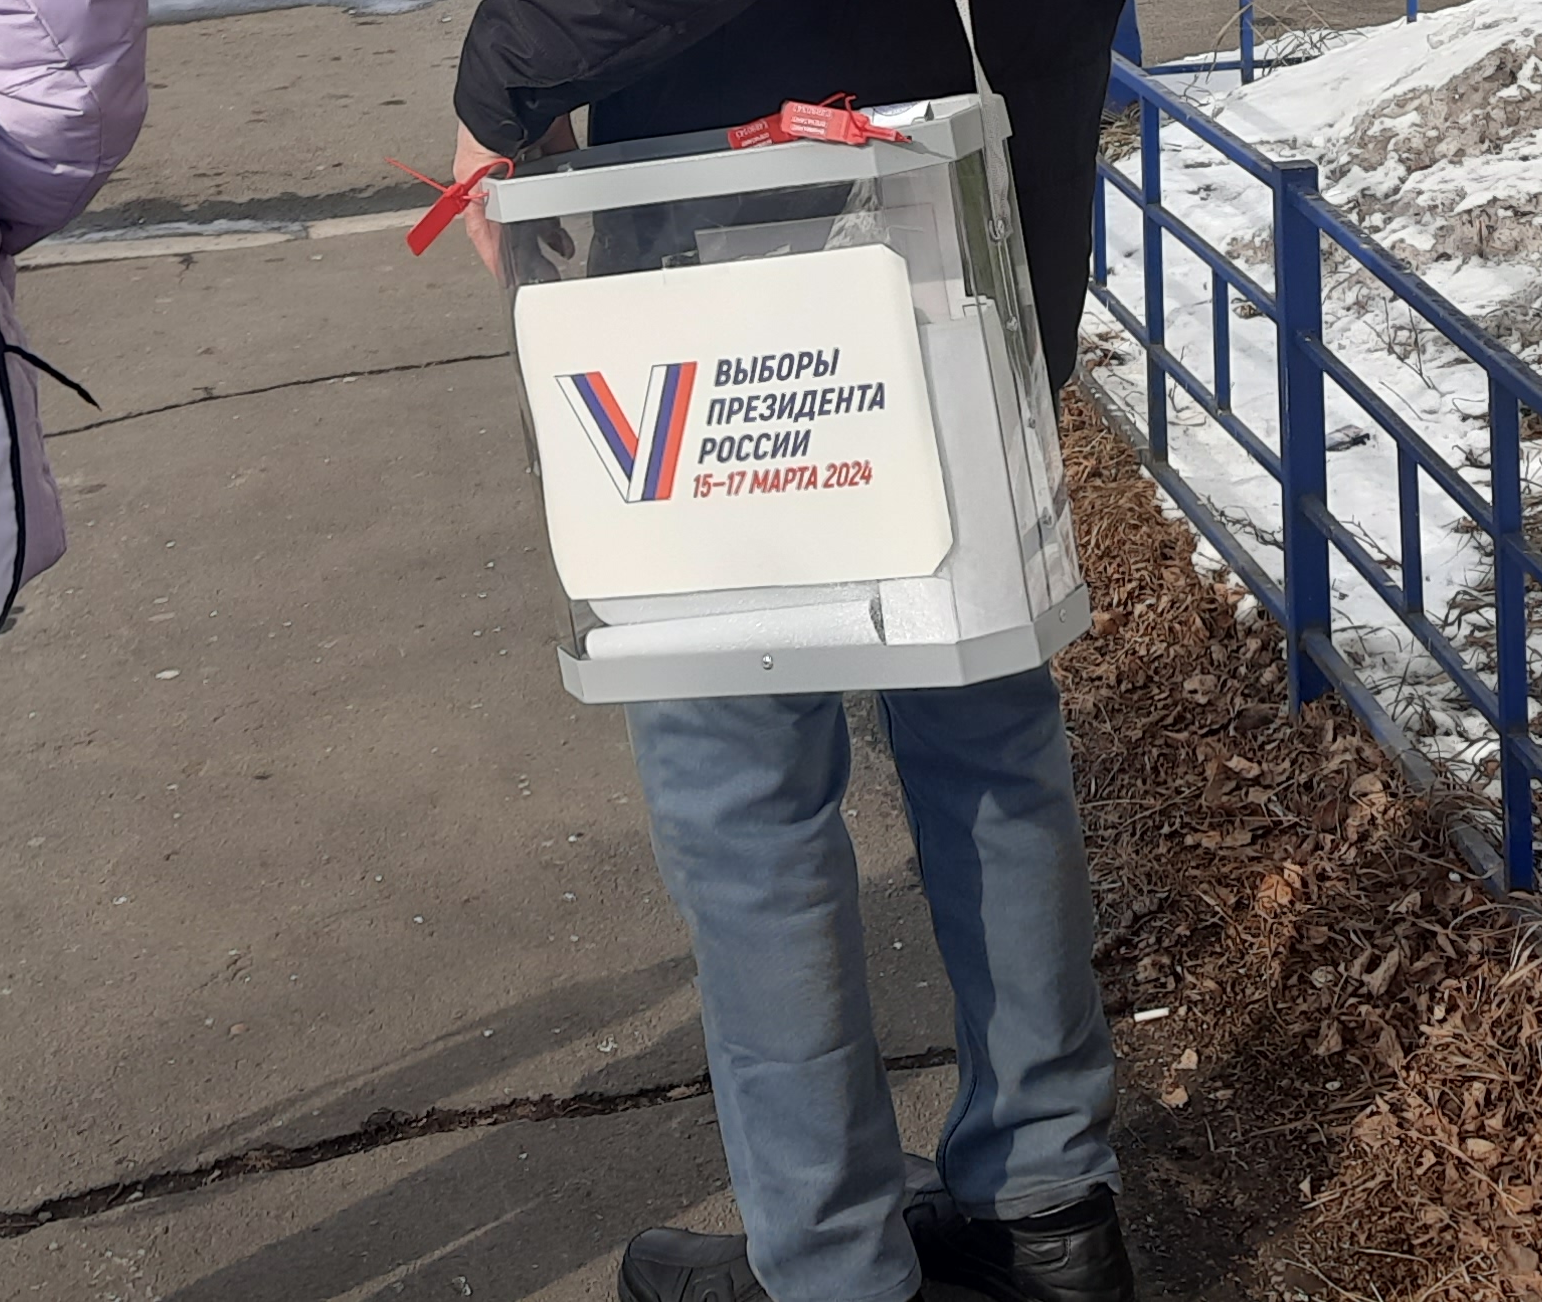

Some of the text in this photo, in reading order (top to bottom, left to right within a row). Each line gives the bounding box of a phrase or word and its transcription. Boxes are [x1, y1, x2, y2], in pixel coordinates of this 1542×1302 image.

[714, 348, 840, 387] ВЫБОРЫ
[706, 382, 885, 426] ПРЕЗИДЕНТА
[698, 429, 812, 464] РОССИИ
[749, 465, 819, 494] МАРТА
[823, 460, 873, 488] 2024
